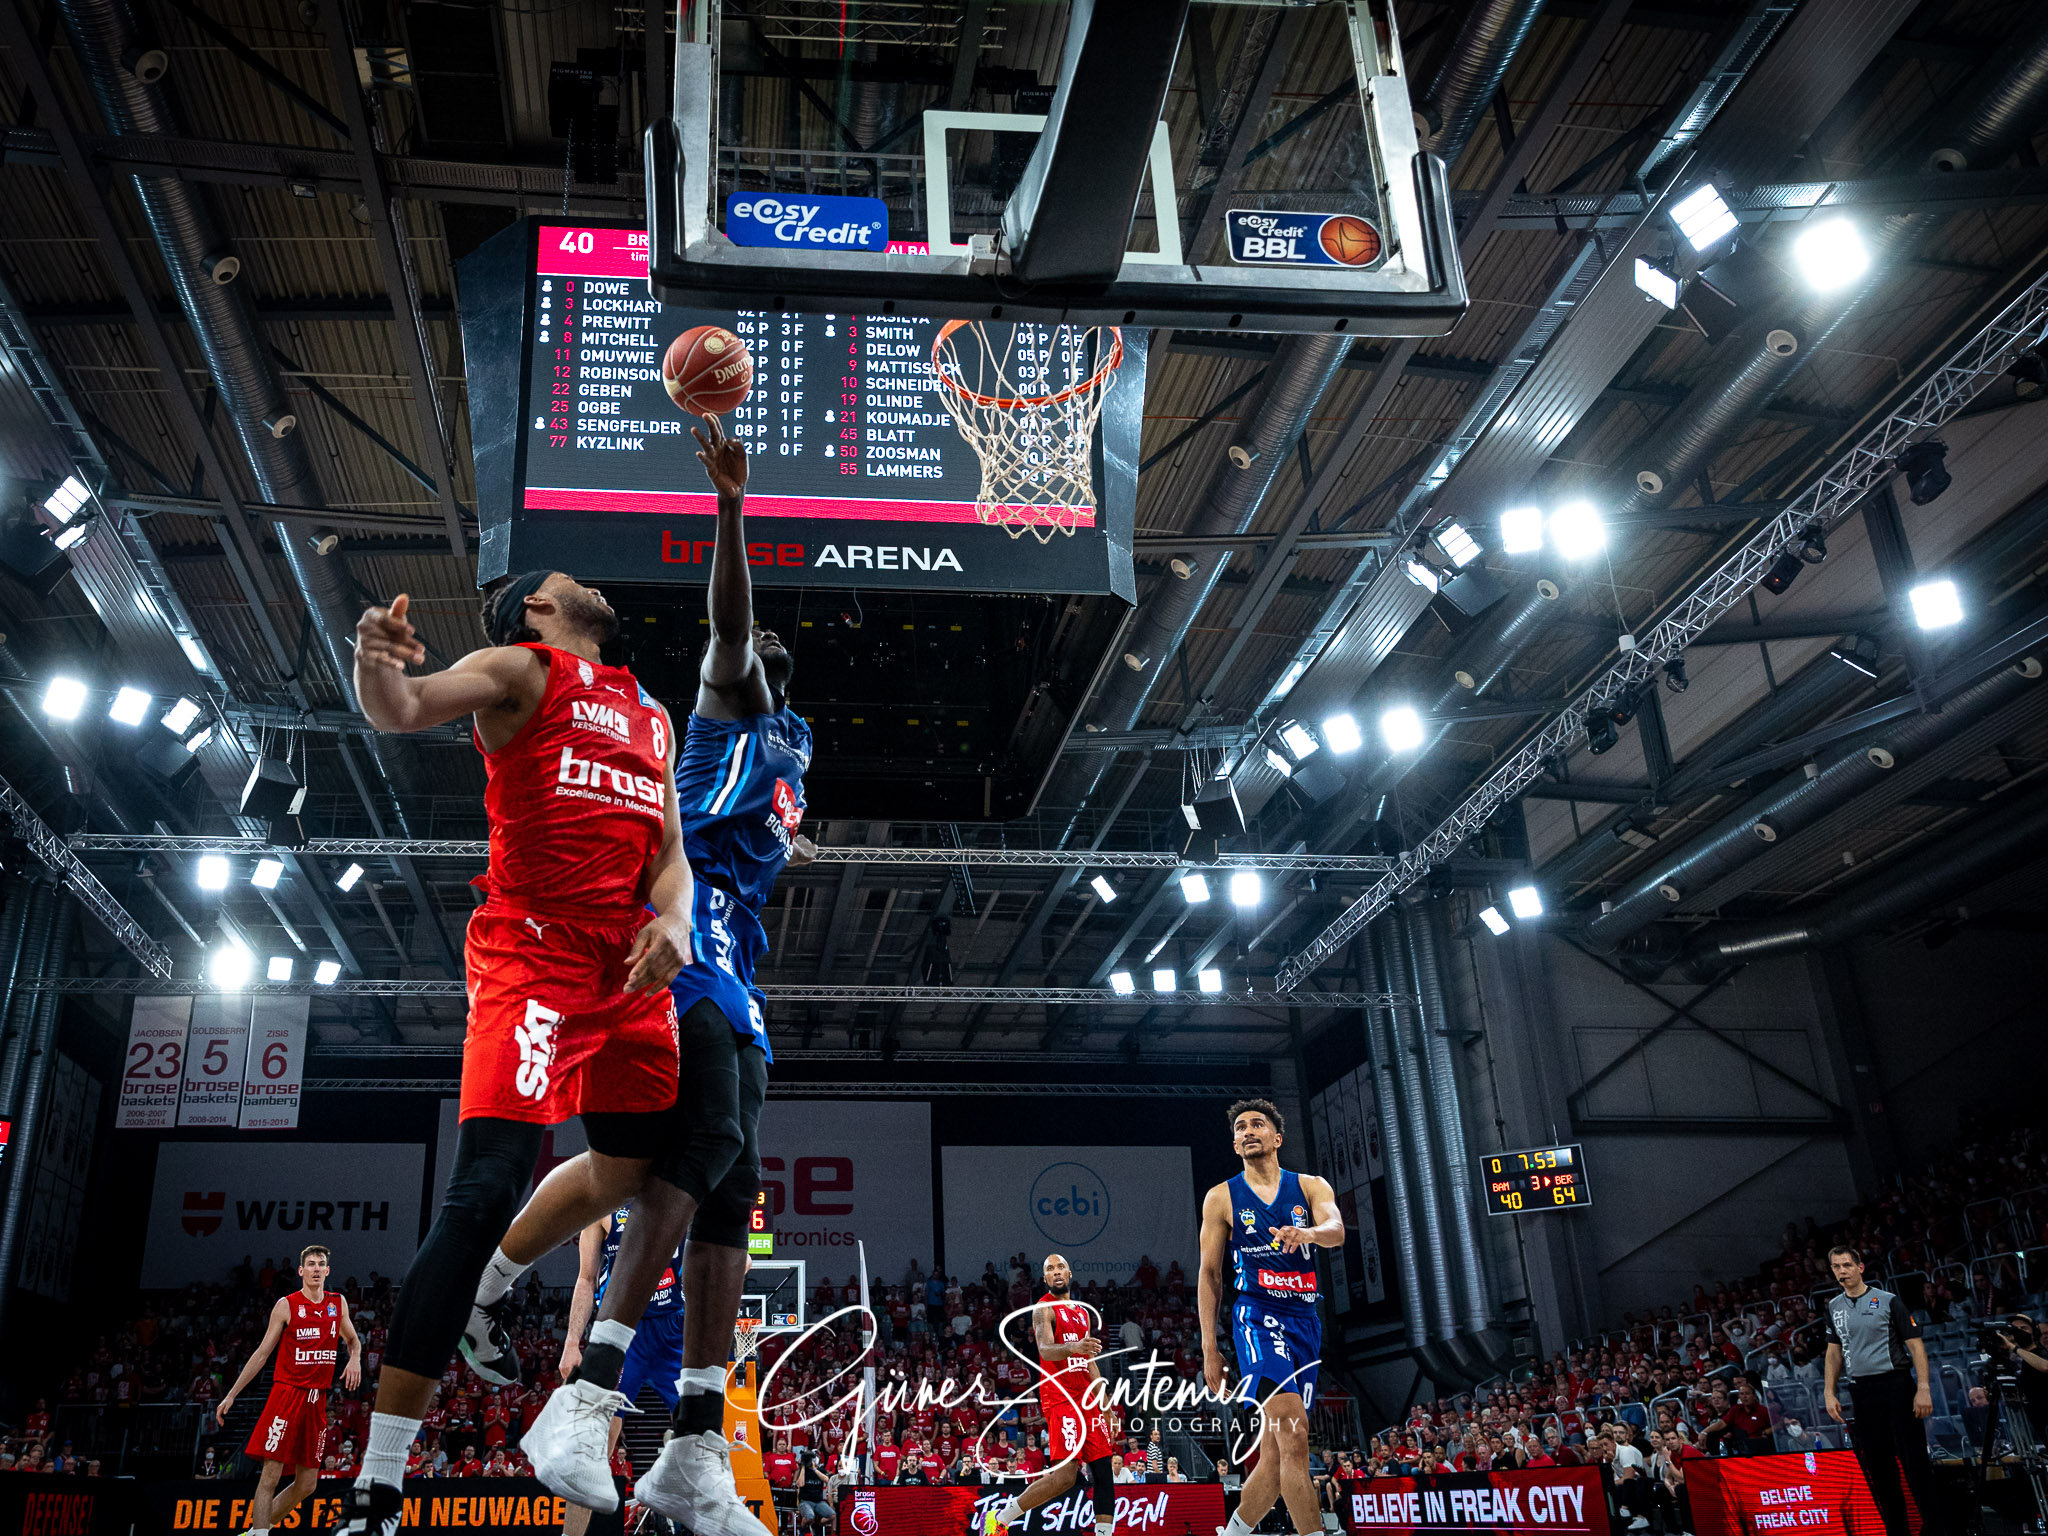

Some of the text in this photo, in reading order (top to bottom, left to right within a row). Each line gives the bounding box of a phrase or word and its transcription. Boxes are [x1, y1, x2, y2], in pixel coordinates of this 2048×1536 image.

[559, 231, 594, 254] 40
[1242, 237, 1307, 260] BBL
[566, 281, 629, 296] 0 DOWE
[565, 298, 662, 314] 3 LOCKHART
[564, 315, 804, 336] 4 PREWITT 06 P 3 F
[563, 332, 804, 353] 8 MITCHELL P 0 F
[848, 326, 1083, 347] 3 SMITH 09 P 2 F
[554, 349, 571, 361] 11
[580, 350, 655, 364] OMUVWIE
[758, 356, 769, 368] P
[781, 357, 790, 369] 0
[794, 357, 803, 369] F
[848, 343, 858, 354] 6
[866, 343, 921, 357] DELOW
[1017, 349, 1036, 361] 05
[1039, 350, 1050, 362] P
[1061, 351, 1070, 363] 0
[553, 366, 570, 378] 12
[579, 366, 661, 382] ROBINSON
[758, 373, 768, 385] P
[781, 374, 790, 386] 0
[793, 374, 803, 386] F
[848, 360, 857, 371] 9
[1018, 366, 1036, 378] 03
[1062, 367, 1069, 379] 1
[841, 376, 858, 389] 10
[552, 383, 803, 404] 22 GEBEN 7 P 0 F
[840, 393, 923, 409] 19 OLINDE
[551, 400, 803, 421] 25 OGBE 01 P 1 F
[839, 411, 858, 423] 21
[866, 411, 951, 427] KOUMADJE
[550, 418, 803, 438] 43 SENGFELDER 08 P 1 F
[839, 429, 858, 441] 45
[866, 429, 915, 443] BLATT
[549, 435, 803, 456] 77 KYZLINK 2 P 0 F
[839, 445, 941, 461] 50 ZOOSMAN
[839, 463, 944, 479] 55 LAMMERS
[661, 529, 964, 572] brse ARENA
[571, 700, 616, 730] LVM
[571, 720, 631, 745] VERSICHERUNG
[650, 716, 666, 760] 8
[555, 785, 623, 807] Excellence in
[134, 1029, 183, 1038] JACOBSEN
[192, 1027, 247, 1035] GOLDSBERRY
[266, 1030, 289, 1038] ZISIS
[202, 1039, 229, 1076] 5
[514, 998, 561, 1101] SIXT
[125, 1042, 182, 1079] 23
[261, 1042, 289, 1079] 6
[123, 1080, 177, 1094] brose
[184, 1078, 240, 1092] brose
[245, 1081, 299, 1095] brose
[121, 1095, 176, 1106] baskets
[183, 1092, 238, 1104] baskets
[244, 1096, 298, 1107] bamberg
[124, 1118, 166, 1126] 2009-2014
[126, 1110, 167, 1118] 2006-2007
[248, 1118, 289, 1126] 2015-2019
[1491, 1158, 1502, 1174] 0
[1492, 1174, 1574, 1192] BAM 3 BER
[1037, 1185, 1100, 1217] cebi
[1500, 1186, 1576, 1209] 40 64
[235, 1200, 390, 1231] WÜRTH
[752, 1209, 765, 1230] 6
[748, 1239, 771, 1249] MER
[774, 1227, 856, 1247] tronics
[296, 1328, 313, 1338] LVM
[330, 1320, 337, 1338] 4
[295, 1347, 338, 1362] brose
[1302, 1382, 1314, 1410] 0
[264, 1415, 286, 1453] SIXT
[1351, 1485, 1584, 1524] BELIEVE IN FREAK CITY
[1759, 1485, 1814, 1506] BELIEVE
[173, 1496, 566, 1530] DIE FAS FAN NEUWAGE
[1041, 1489, 1169, 1533] SHOPEN!
[1754, 1508, 1829, 1530] FREAK CITY
